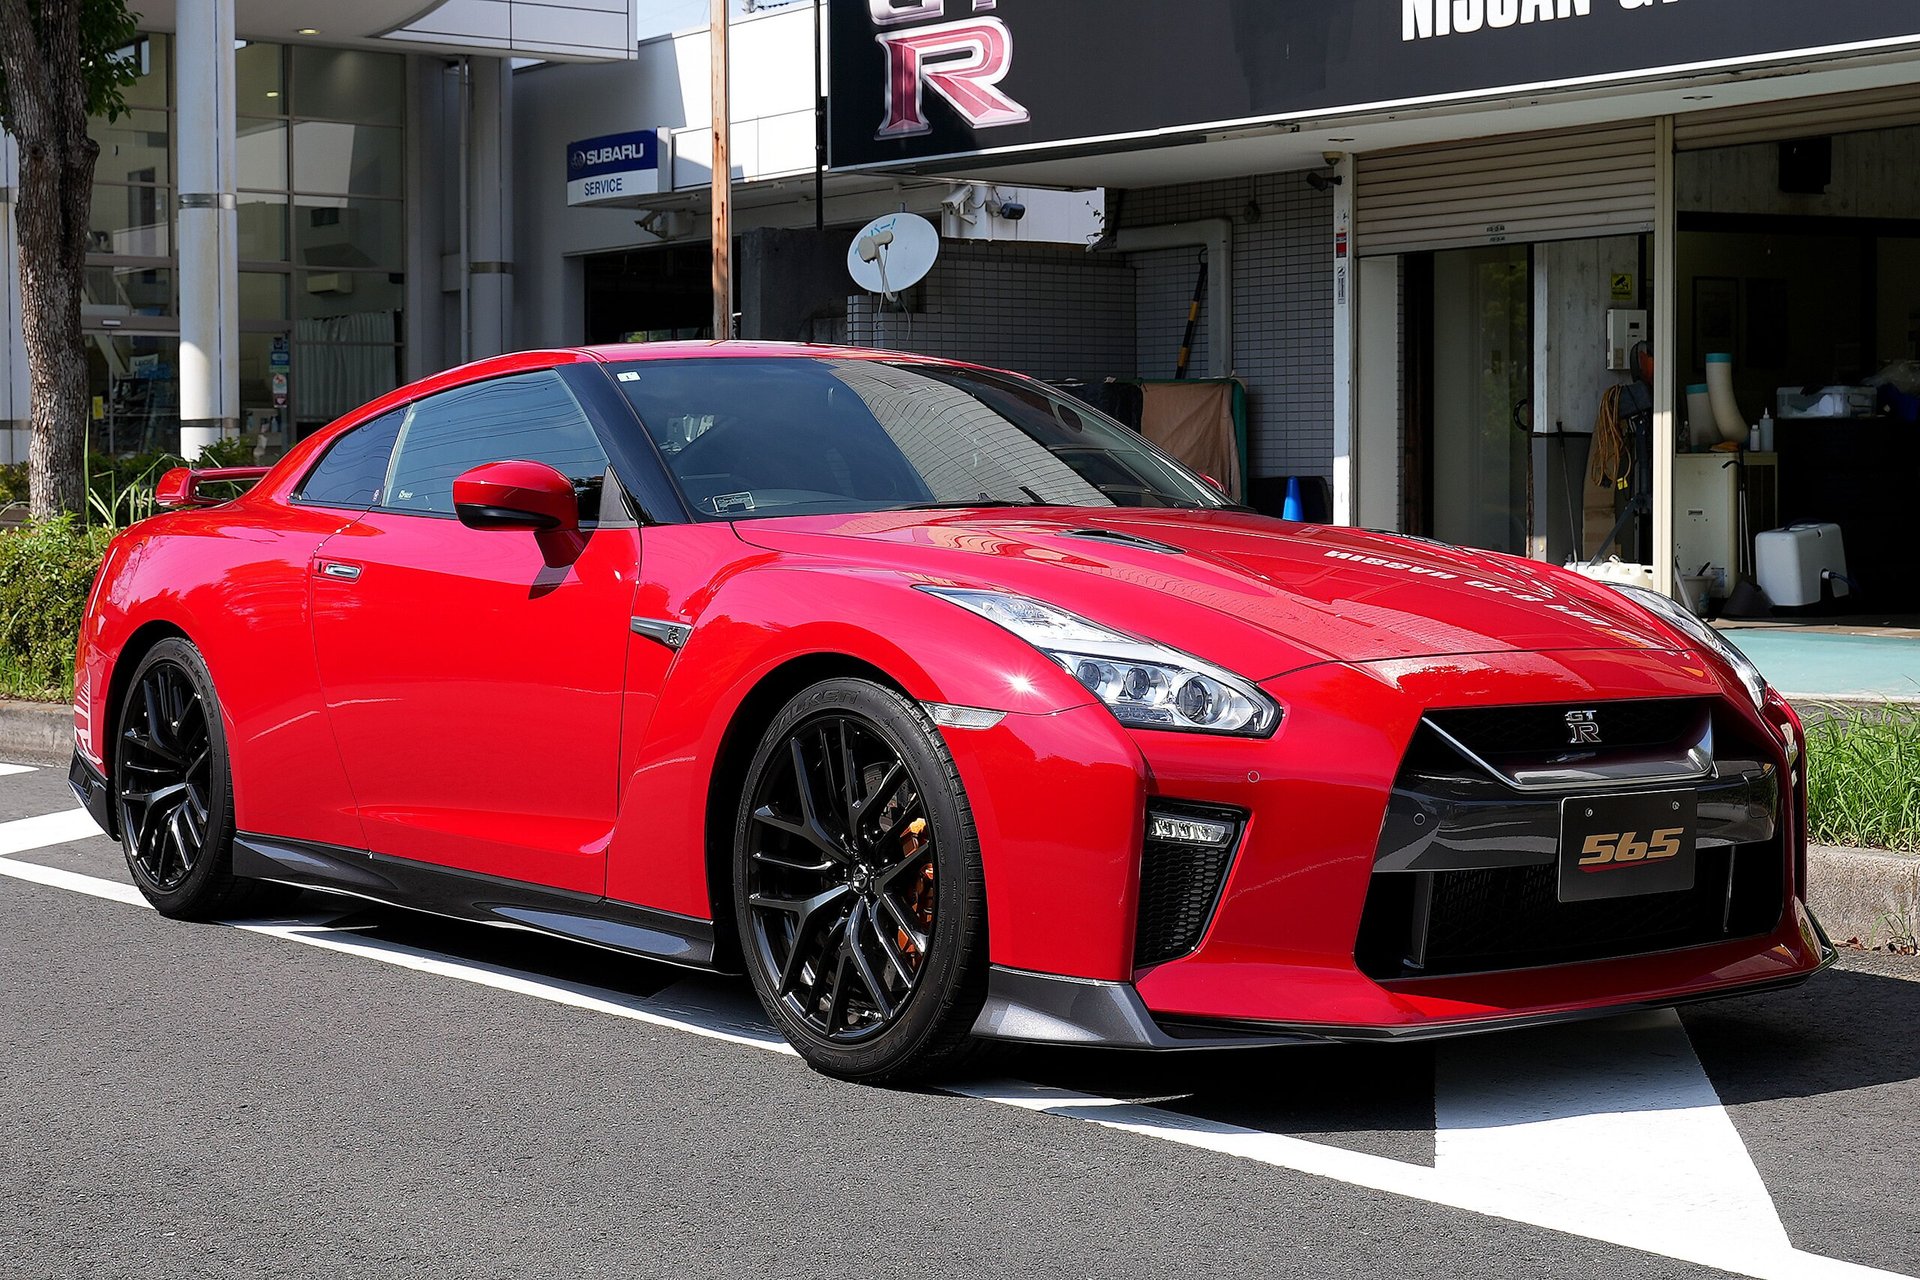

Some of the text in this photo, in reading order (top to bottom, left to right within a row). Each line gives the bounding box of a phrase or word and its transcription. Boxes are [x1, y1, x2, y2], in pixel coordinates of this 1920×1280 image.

[874, 15, 1031, 141] R
[586, 143, 644, 165] SUBARU
[584, 178, 623, 196] SERVICE
[1564, 710, 1597, 722] GT
[1567, 722, 1602, 744] R
[1578, 827, 1685, 865] 565
